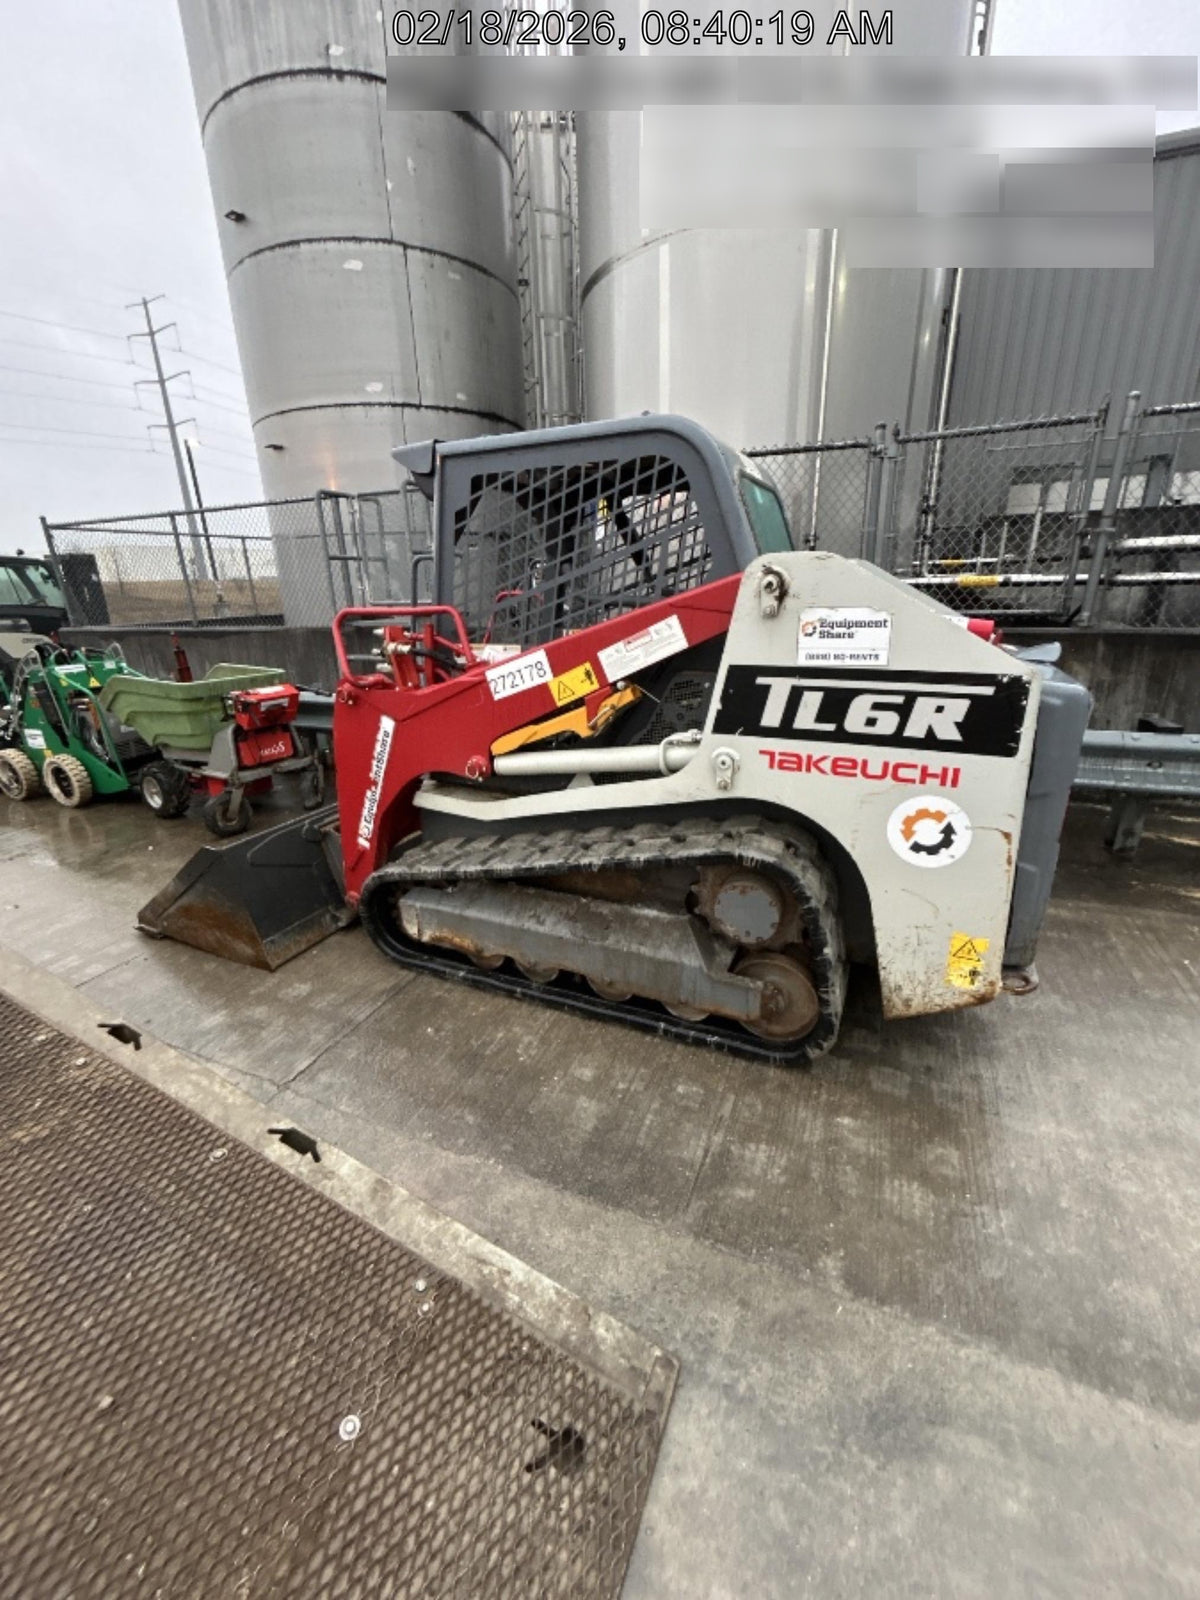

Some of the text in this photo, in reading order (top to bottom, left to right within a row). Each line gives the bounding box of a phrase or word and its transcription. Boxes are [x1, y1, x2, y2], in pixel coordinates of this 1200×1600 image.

[819, 617, 888, 630] Equipment
[819, 630, 855, 639] Share
[489, 661, 546, 694] 272178
[755, 676, 996, 742] TL6R
[759, 750, 961, 788] TAKEUCHI
